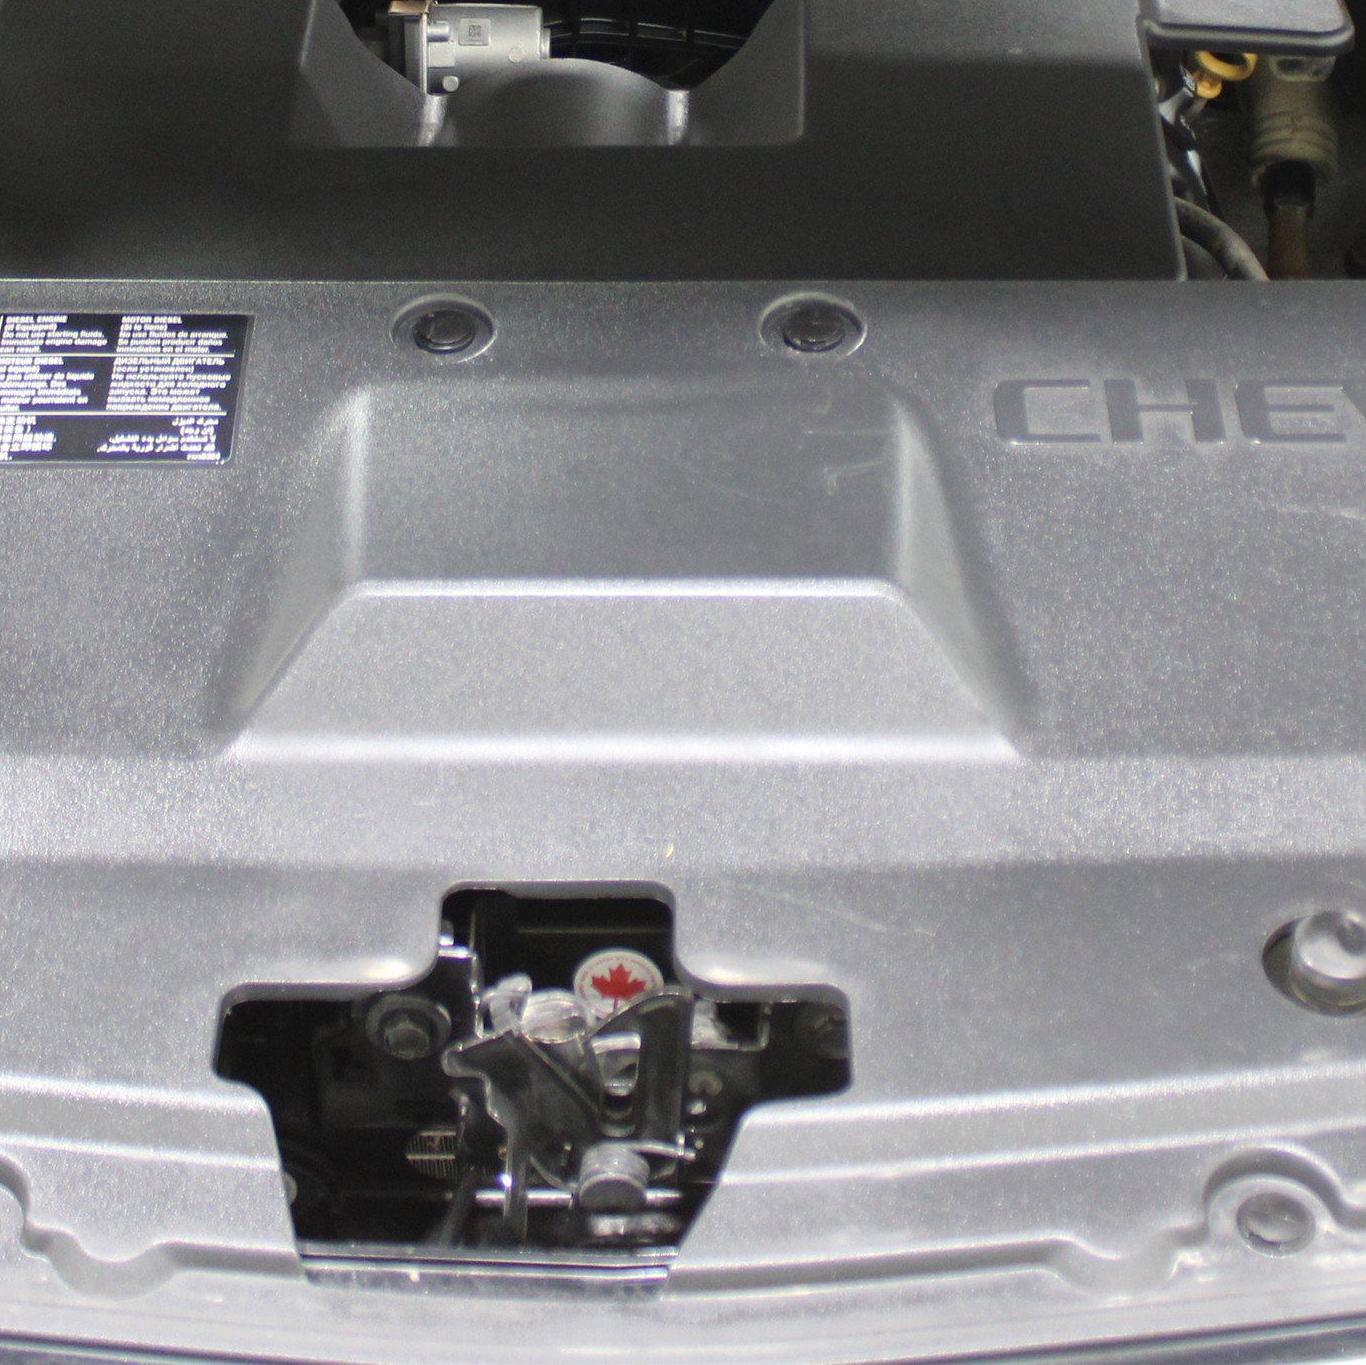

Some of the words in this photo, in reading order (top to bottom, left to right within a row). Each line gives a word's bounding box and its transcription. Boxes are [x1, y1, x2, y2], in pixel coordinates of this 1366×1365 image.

[6, 315, 35, 323] DIESEL
[36, 315, 68, 323] ENGINE
[122, 316, 152, 324] MOTOR
[154, 316, 182, 324] DIESEL
[47, 331, 78, 339] starting
[34, 357, 64, 365] DIESEL
